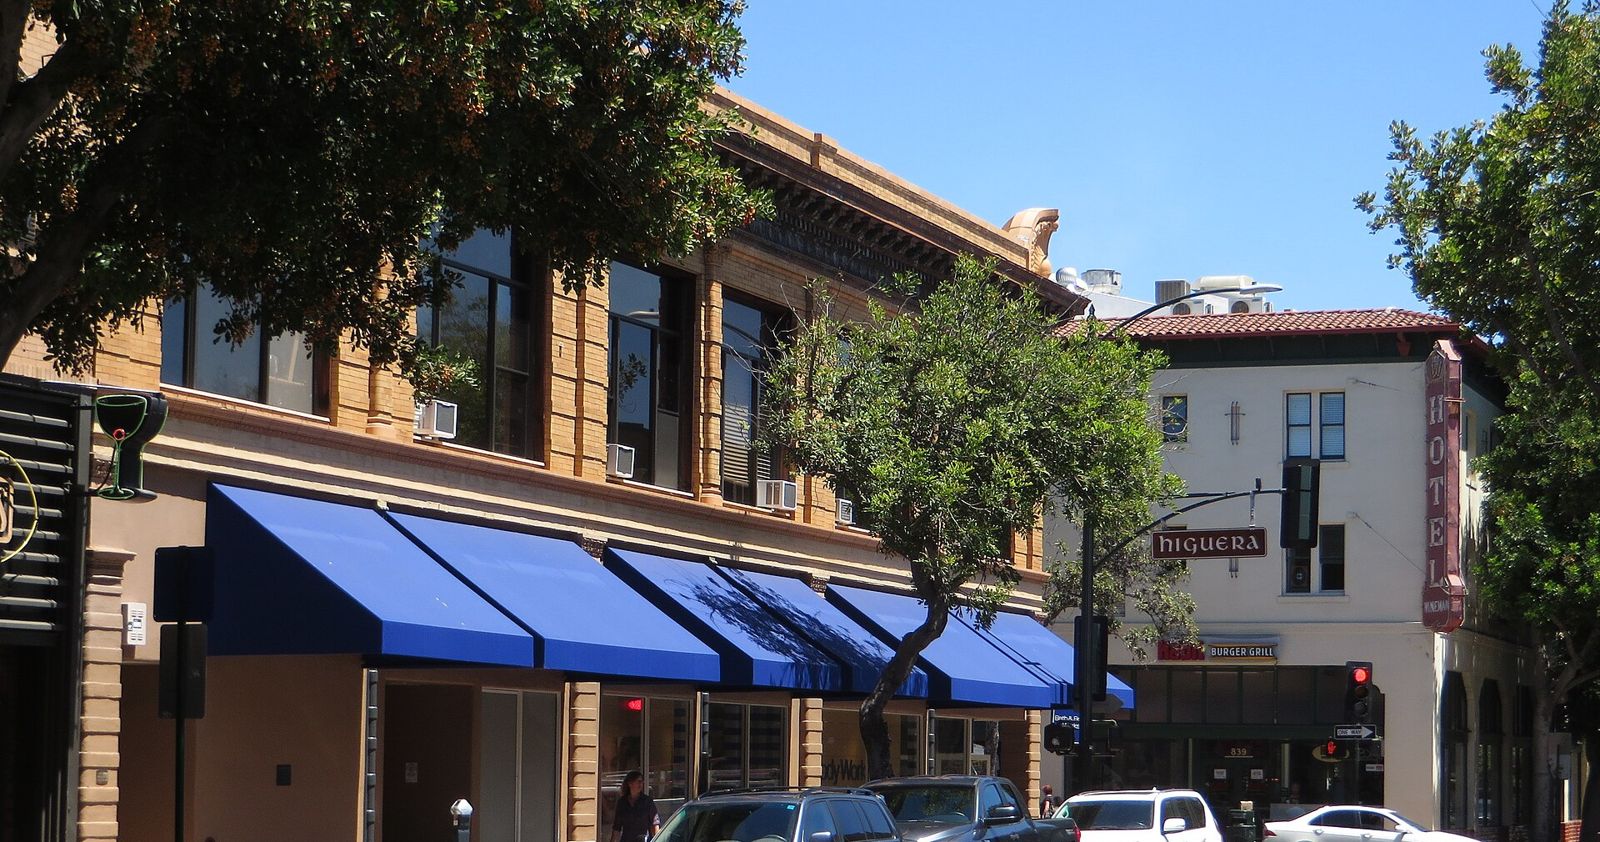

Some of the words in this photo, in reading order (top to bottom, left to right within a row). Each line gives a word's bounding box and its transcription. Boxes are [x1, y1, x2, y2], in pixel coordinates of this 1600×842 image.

[1429, 395, 1445, 588] HOTEL
[1159, 536, 1259, 555] HIGUERA
[1211, 647, 1247, 657] BURGER
[1248, 647, 1274, 656] GRILL
[1230, 747, 1247, 756] 839
